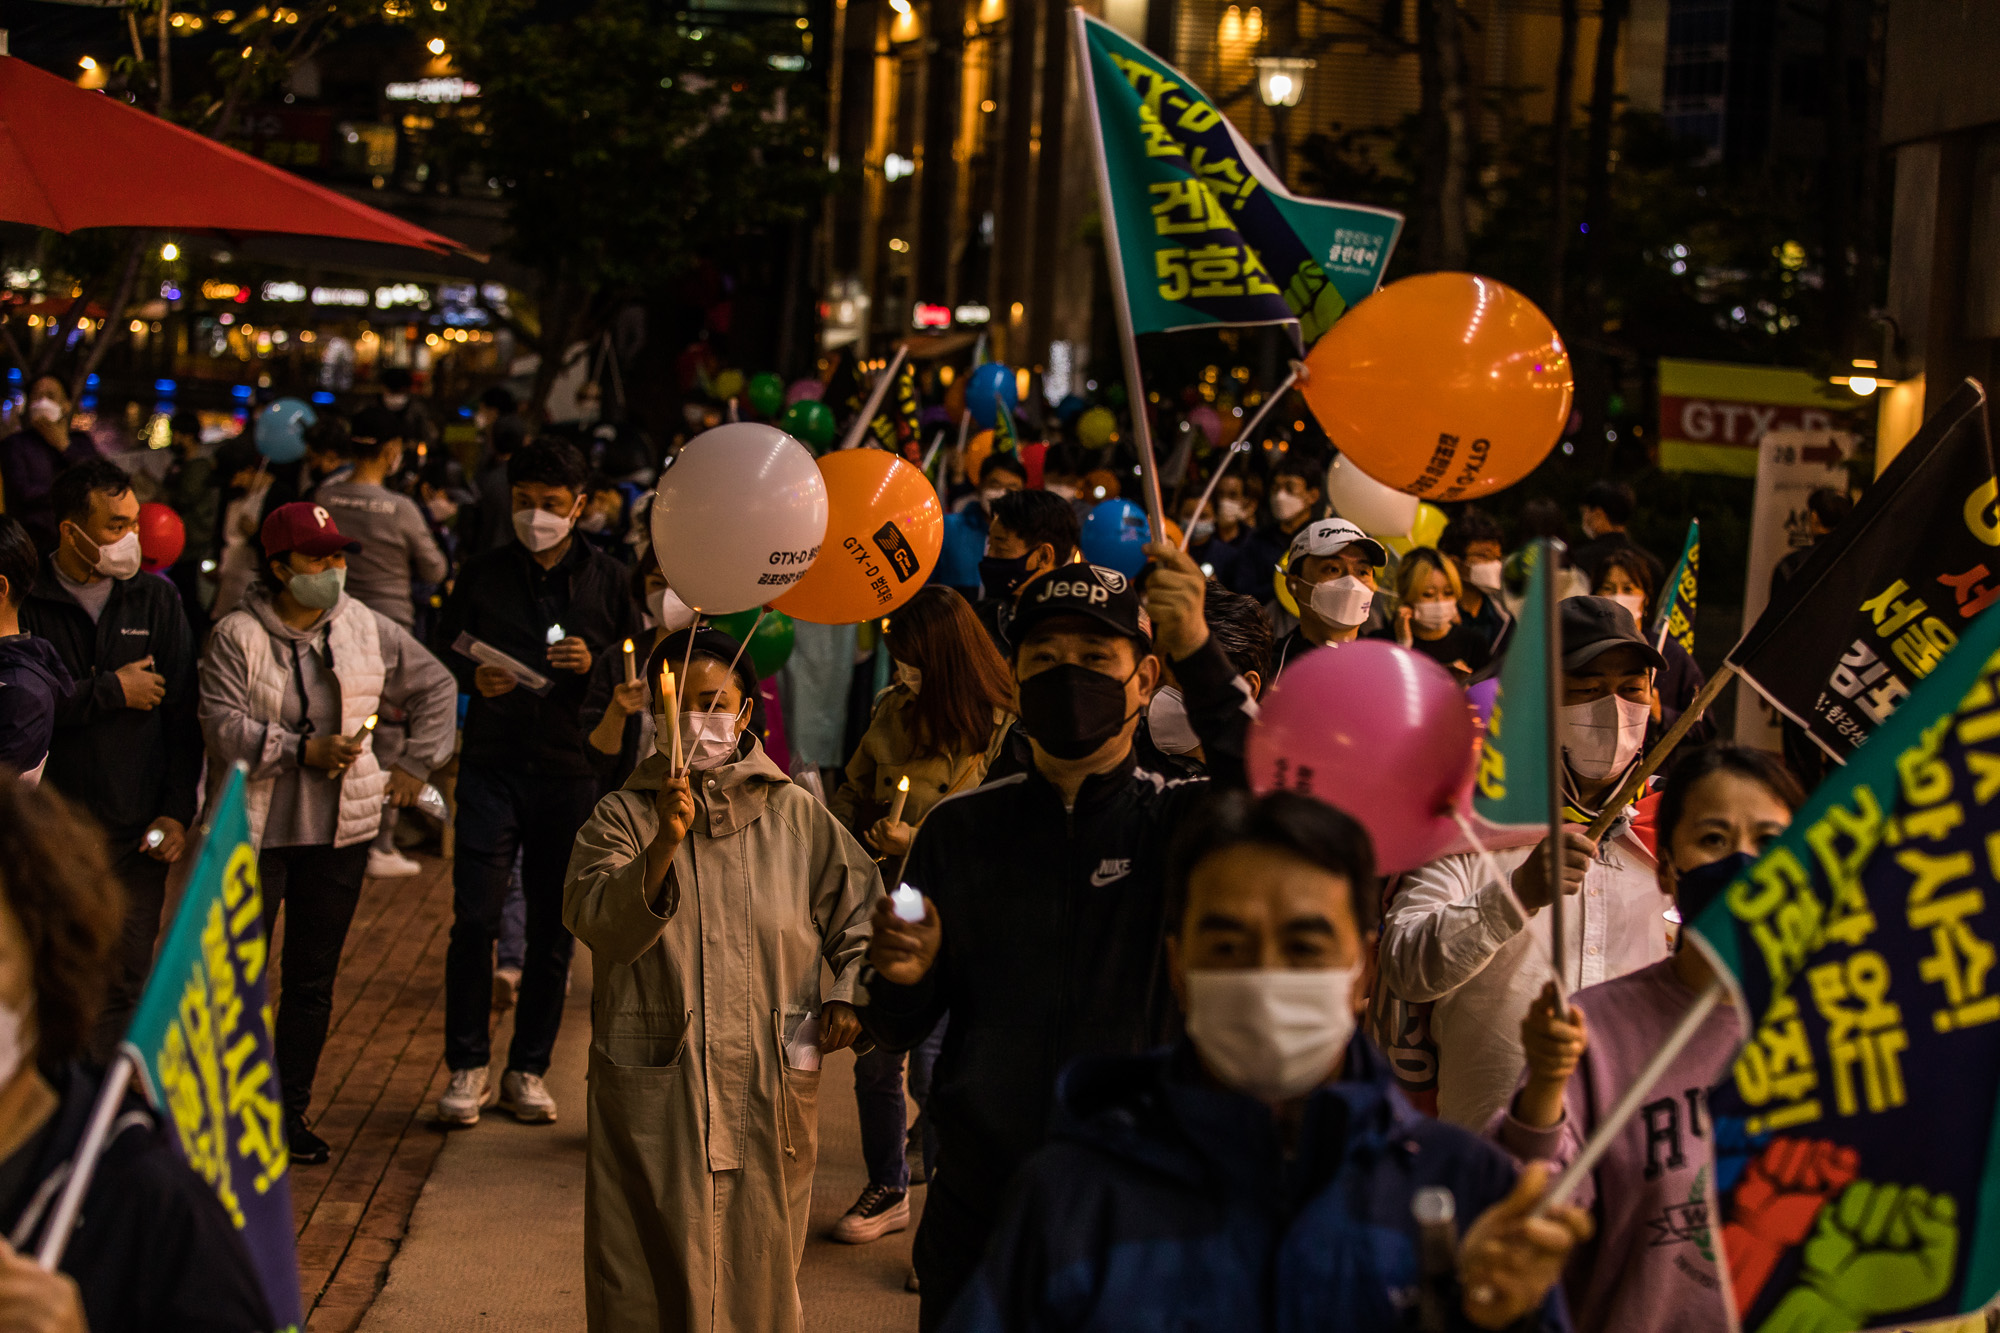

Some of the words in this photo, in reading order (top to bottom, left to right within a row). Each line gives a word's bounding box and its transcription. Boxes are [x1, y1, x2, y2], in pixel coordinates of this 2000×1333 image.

[313, 505, 330, 529] P
[769, 550, 807, 565] GTX-D
[843, 537, 880, 577] GTX-D
[1036, 579, 1109, 605] Jeep
[1859, 578, 1959, 679] 서울
[1100, 858, 1132, 875] NIKE
